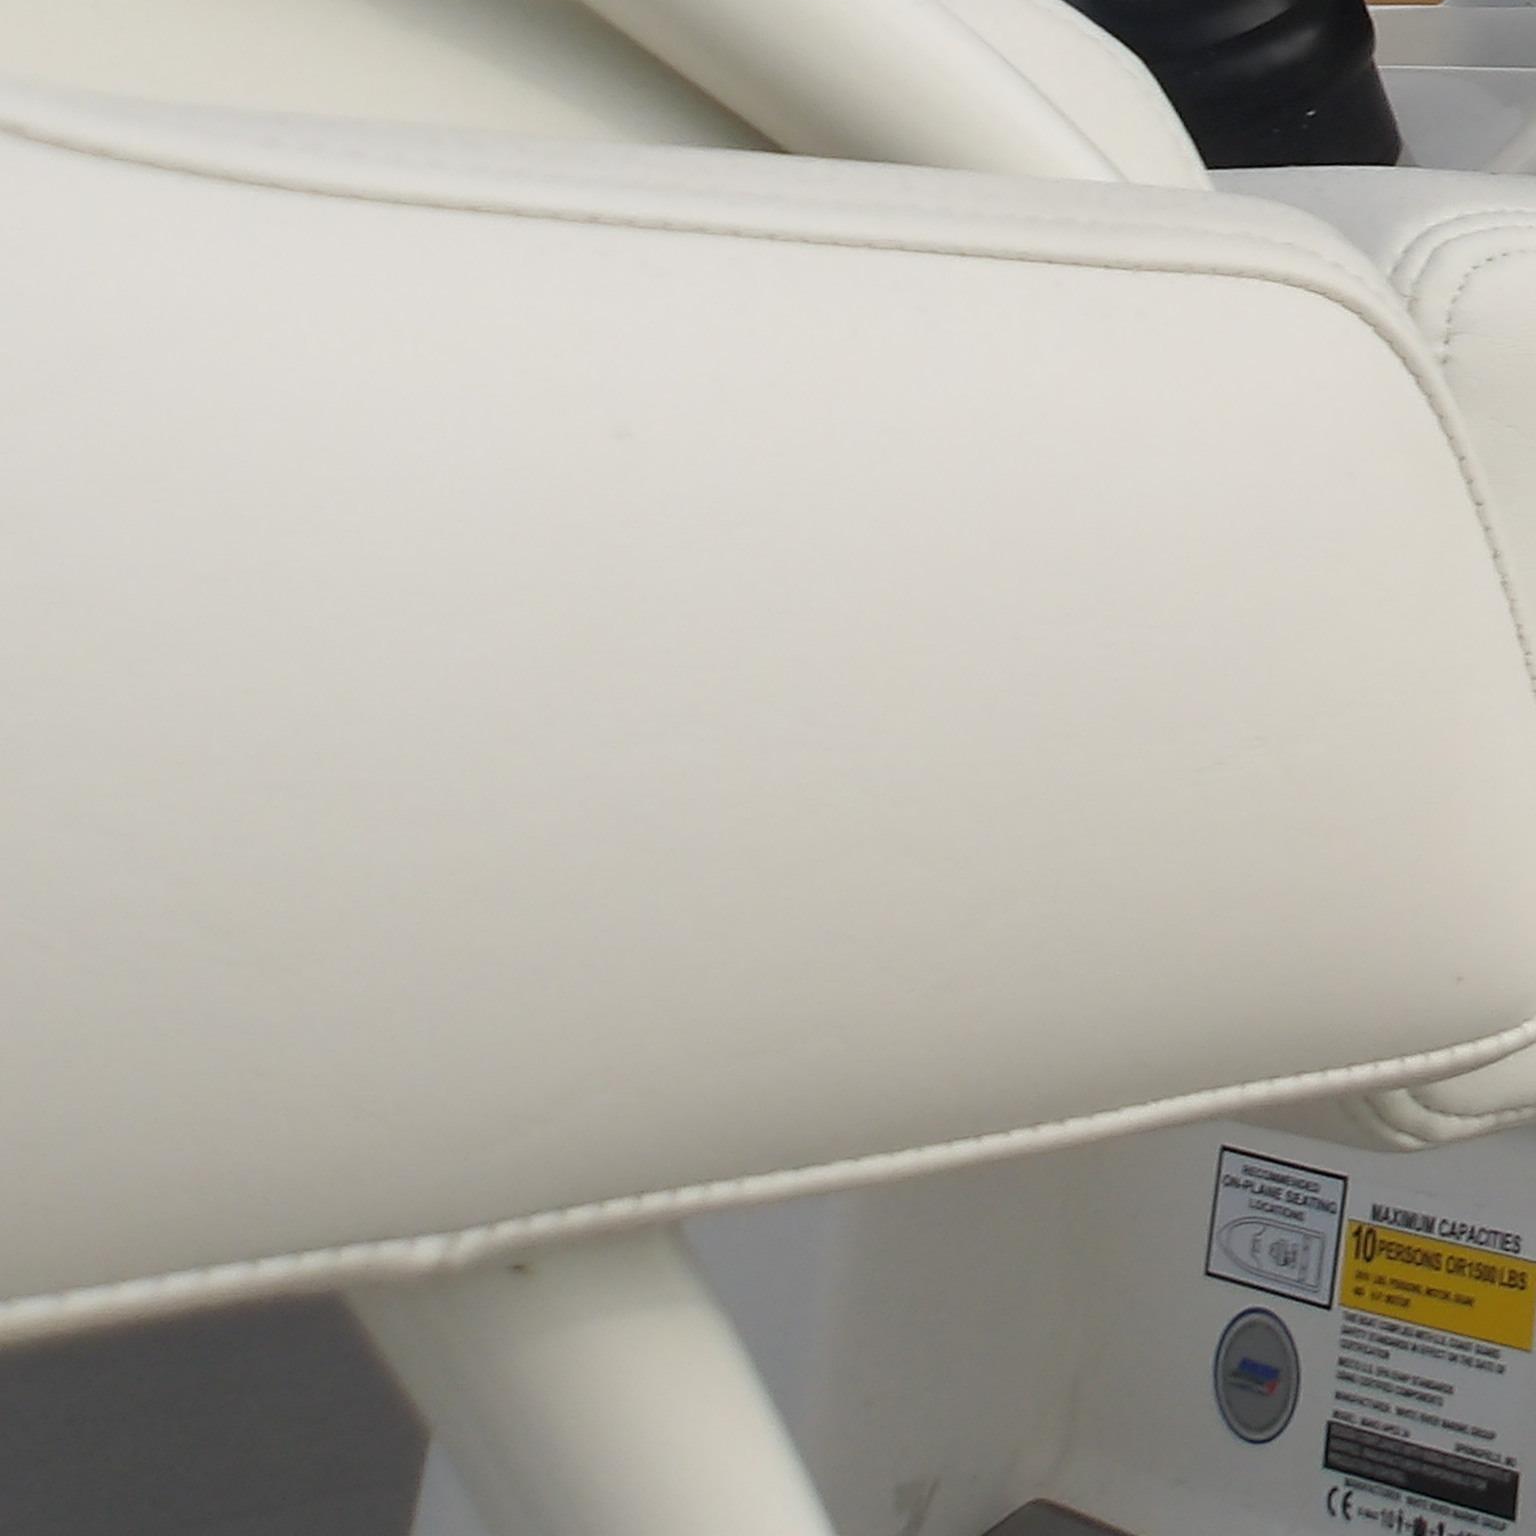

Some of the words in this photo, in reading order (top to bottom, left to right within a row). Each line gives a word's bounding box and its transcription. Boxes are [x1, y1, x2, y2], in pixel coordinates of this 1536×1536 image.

[1351, 1223, 1375, 1264] 10
[1378, 1238, 1442, 1271] PERSONS
[1498, 1268, 1529, 1292] LBS
[1371, 1203, 1436, 1235] MAXIMUM
[1437, 1217, 1522, 1254] CAPACITIES
